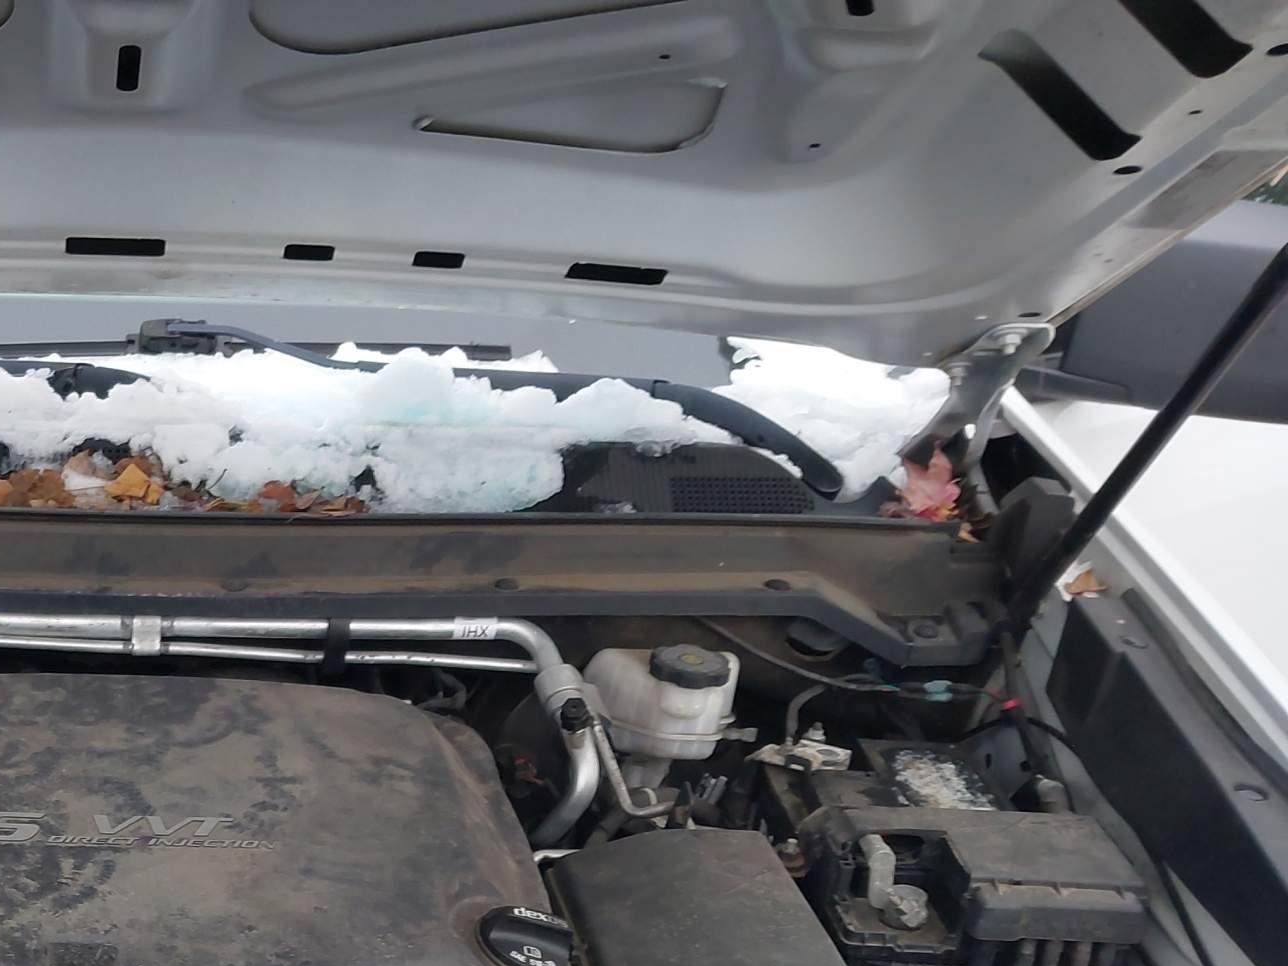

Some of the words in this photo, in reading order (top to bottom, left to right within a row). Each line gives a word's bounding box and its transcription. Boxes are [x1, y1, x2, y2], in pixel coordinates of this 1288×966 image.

[461, 624, 489, 638] IHX
[92, 813, 235, 838] VVT
[47, 834, 138, 847] DIRECT
[147, 836, 277, 850] INJECTION
[509, 950, 527, 963] SAE
